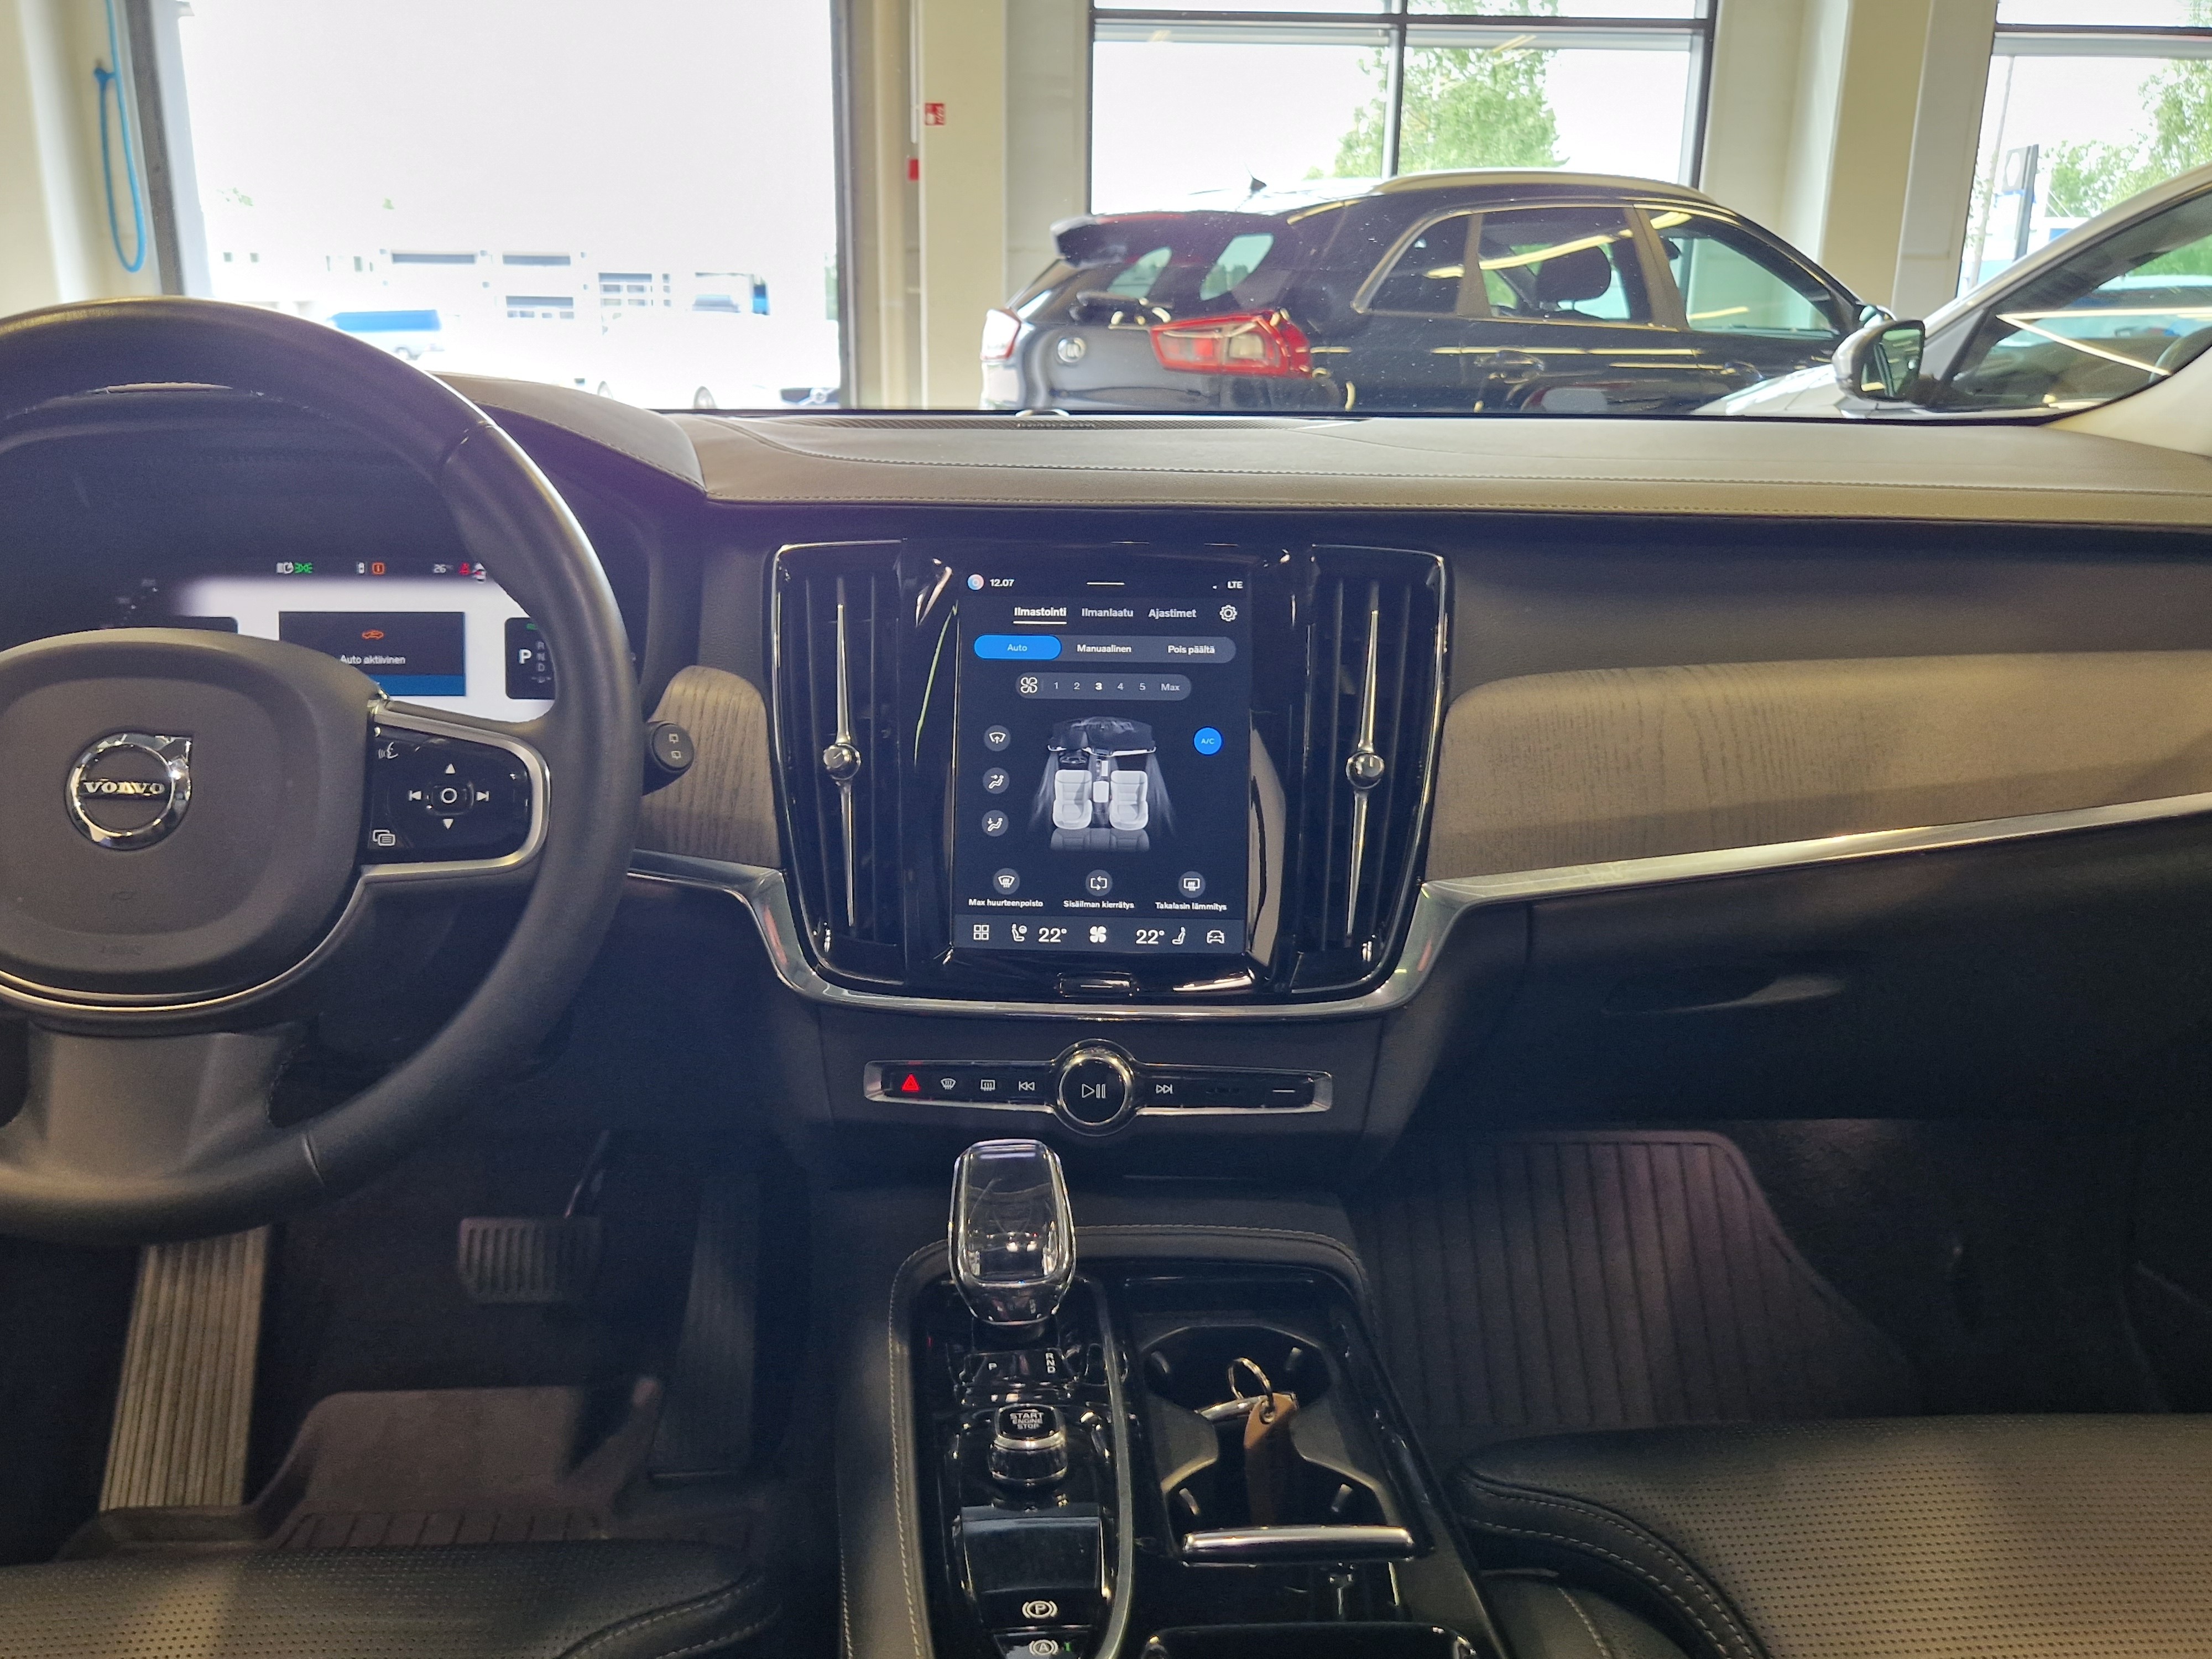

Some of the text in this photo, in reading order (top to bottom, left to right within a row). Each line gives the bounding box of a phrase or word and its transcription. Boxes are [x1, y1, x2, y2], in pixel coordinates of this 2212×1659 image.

[990, 578, 1014, 587] 12.07
[1227, 581, 1243, 589] LTE
[1014, 607, 1067, 617] Ilmastointi
[1081, 608, 1134, 618] Ilmanlaatu
[1149, 608, 1197, 619] Ajastimet
[1007, 643, 1027, 652] Auto
[1077, 644, 1131, 653] Manuaalinen
[1167, 645, 1215, 655] Pois päältä
[340, 654, 362, 664] Auto
[519, 649, 531, 664] P
[538, 663, 545, 672] D
[1073, 682, 1080, 690] 2
[1095, 682, 1102, 691] 3
[1117, 682, 1124, 691] 4
[1139, 683, 1146, 691] 5
[1161, 683, 1180, 692] Max
[1201, 737, 1214, 745] A/C
[84, 781, 165, 795] VOLVO
[987, 899, 1044, 908] huurteenpoisto
[1063, 900, 1135, 910] Sisäilman kierrätys
[1155, 902, 1227, 912] Takalasin lämmitys
[1039, 928, 1067, 942] 22°
[1136, 930, 1165, 944] 22°
